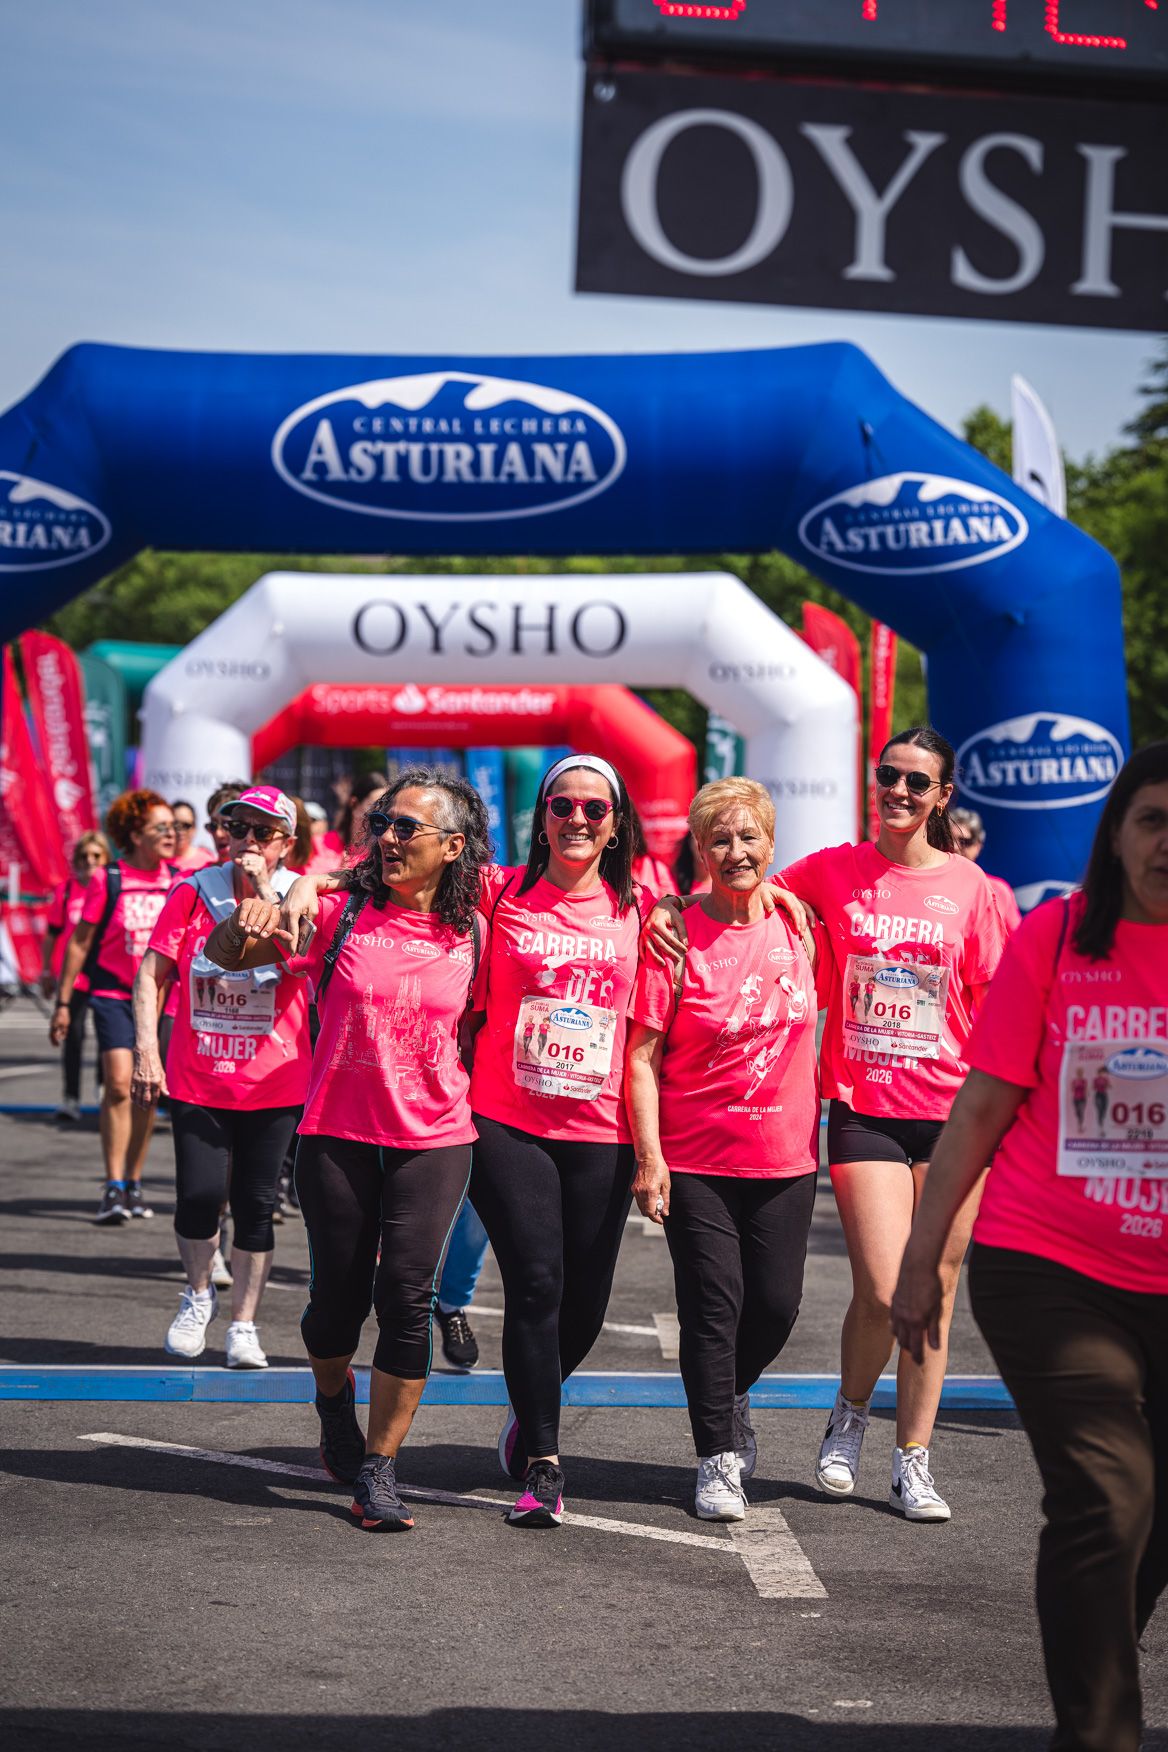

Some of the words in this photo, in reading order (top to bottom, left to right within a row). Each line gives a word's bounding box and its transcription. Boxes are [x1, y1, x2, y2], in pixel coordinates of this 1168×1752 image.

[353, 417, 463, 434] CENTRAL
[474, 418, 587, 435] LECHERA
[301, 418, 598, 483] ASTURIANA
[819, 515, 1013, 552] ASTURIANA
[350, 599, 628, 658] OYSHO
[185, 660, 271, 680] OYSHO
[708, 661, 796, 684] OYSHO
[312, 684, 391, 715] Sports
[426, 686, 556, 714] Santander
[964, 752, 1116, 787] ASTURIANA
[764, 778, 838, 800] YSHO
[852, 889, 891, 899] OYSHO
[515, 913, 556, 923] OYSHO
[850, 912, 944, 947] CARRERA
[405, 945, 437, 956] ASTURIANA
[517, 931, 617, 963] CARRERA
[696, 956, 738, 972] OYSHO
[855, 964, 874, 973] SUMA
[878, 972, 916, 985] ASTURIANA
[217, 992, 247, 1007] 016
[530, 1004, 550, 1013] SUMA
[873, 1002, 911, 1020] 016
[554, 1012, 590, 1028] ASTURIANA
[1066, 1005, 1168, 1041] CARRE
[850, 1034, 880, 1046] OYSHO
[877, 1028, 894, 1036] MUJER
[197, 1032, 256, 1060] MUJER
[547, 1043, 585, 1062] 016
[898, 1042, 928, 1052] Santander
[213, 1061, 236, 1074] 2026
[551, 1069, 567, 1078] MUJER
[556, 1061, 574, 1071] 2017
[524, 1074, 553, 1088] OYSHO
[866, 1067, 893, 1085] 2026
[570, 1085, 592, 1094] Santander
[727, 1105, 751, 1113] CARRERA
[767, 1105, 783, 1113] MUJER
[1112, 1103, 1167, 1127] 016
[1077, 1158, 1126, 1169] OYSHO
[1120, 1213, 1163, 1238] 2026
